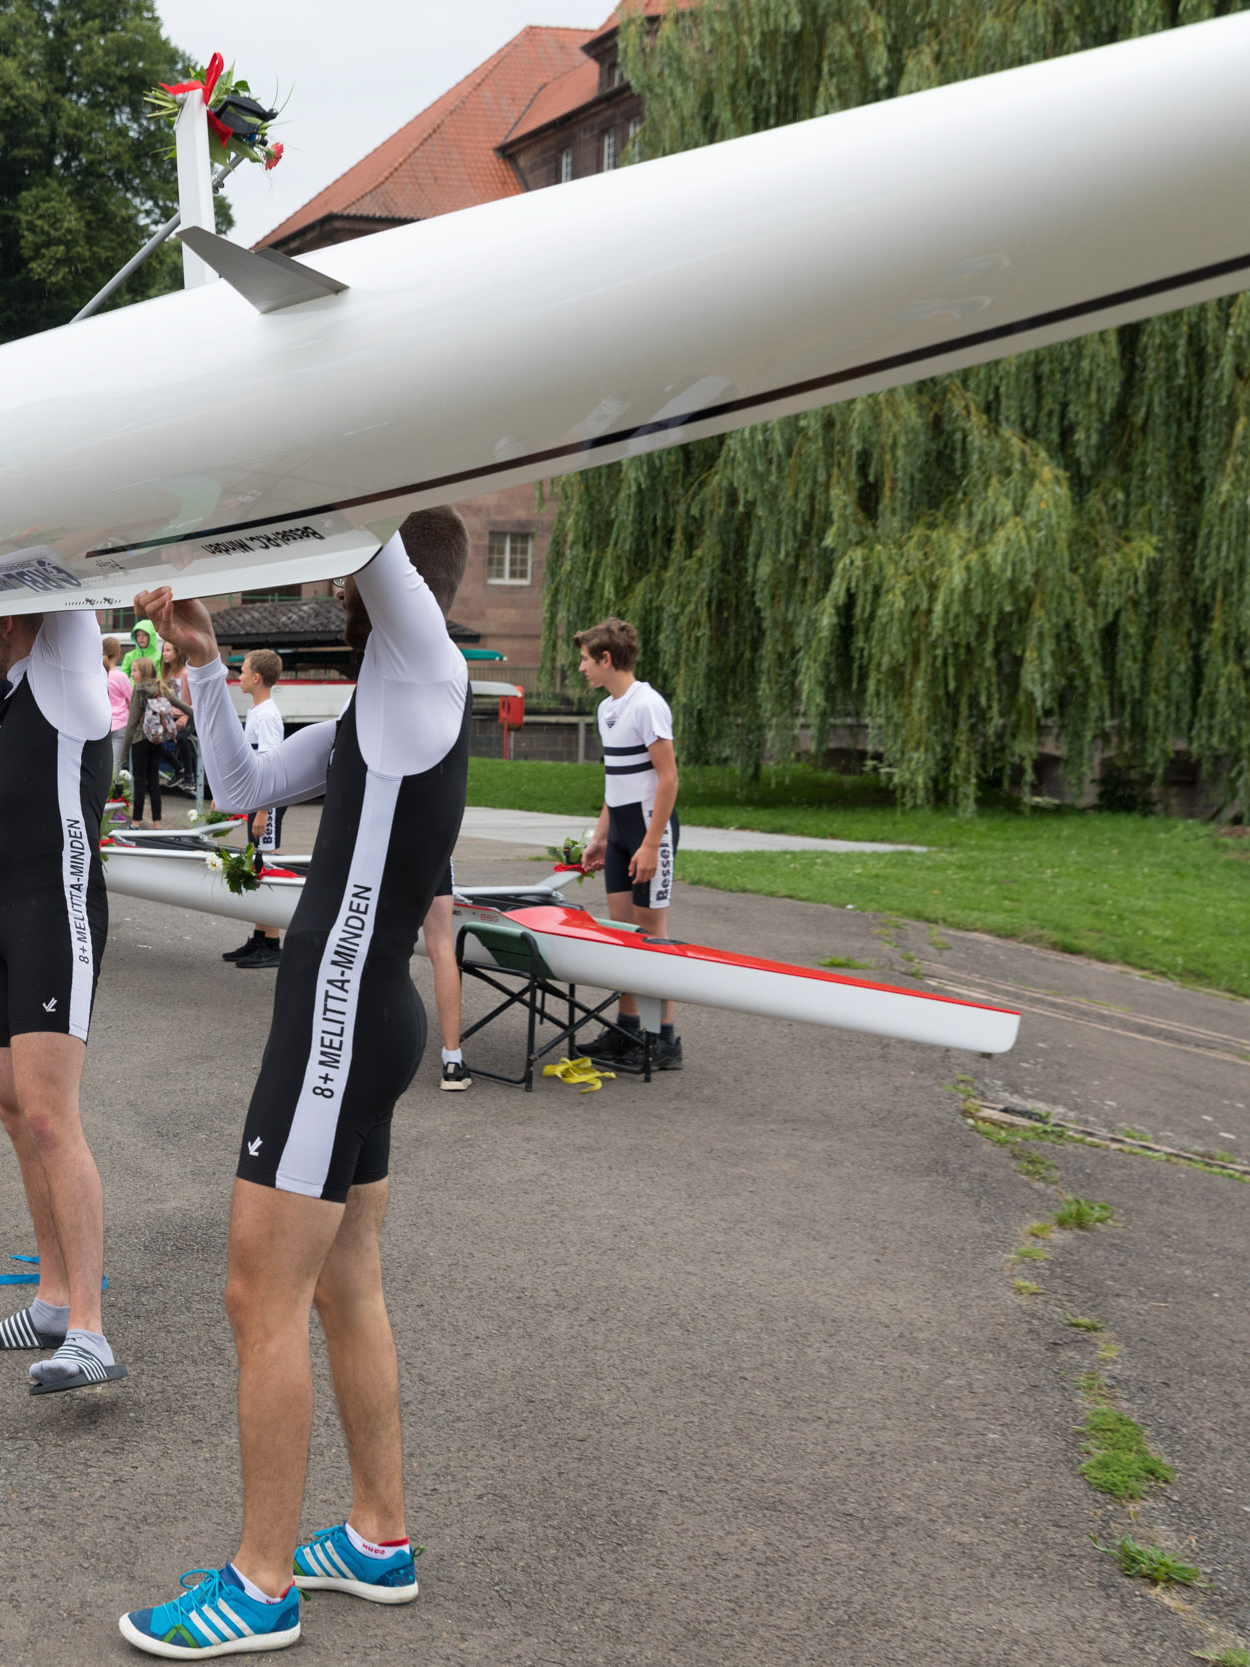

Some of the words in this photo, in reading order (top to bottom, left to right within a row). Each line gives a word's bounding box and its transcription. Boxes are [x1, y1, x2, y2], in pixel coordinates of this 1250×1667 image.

[201, 538, 255, 556] Minden
[66, 818, 88, 944] MELITTA-MINDEN
[480, 913, 499, 922] BBG
[79, 945, 90, 965] 8+
[318, 884, 372, 1070] MELITTA-MINDEN
[312, 1072, 335, 1100] 8+
[362, 1543, 385, 1555] HUGO
